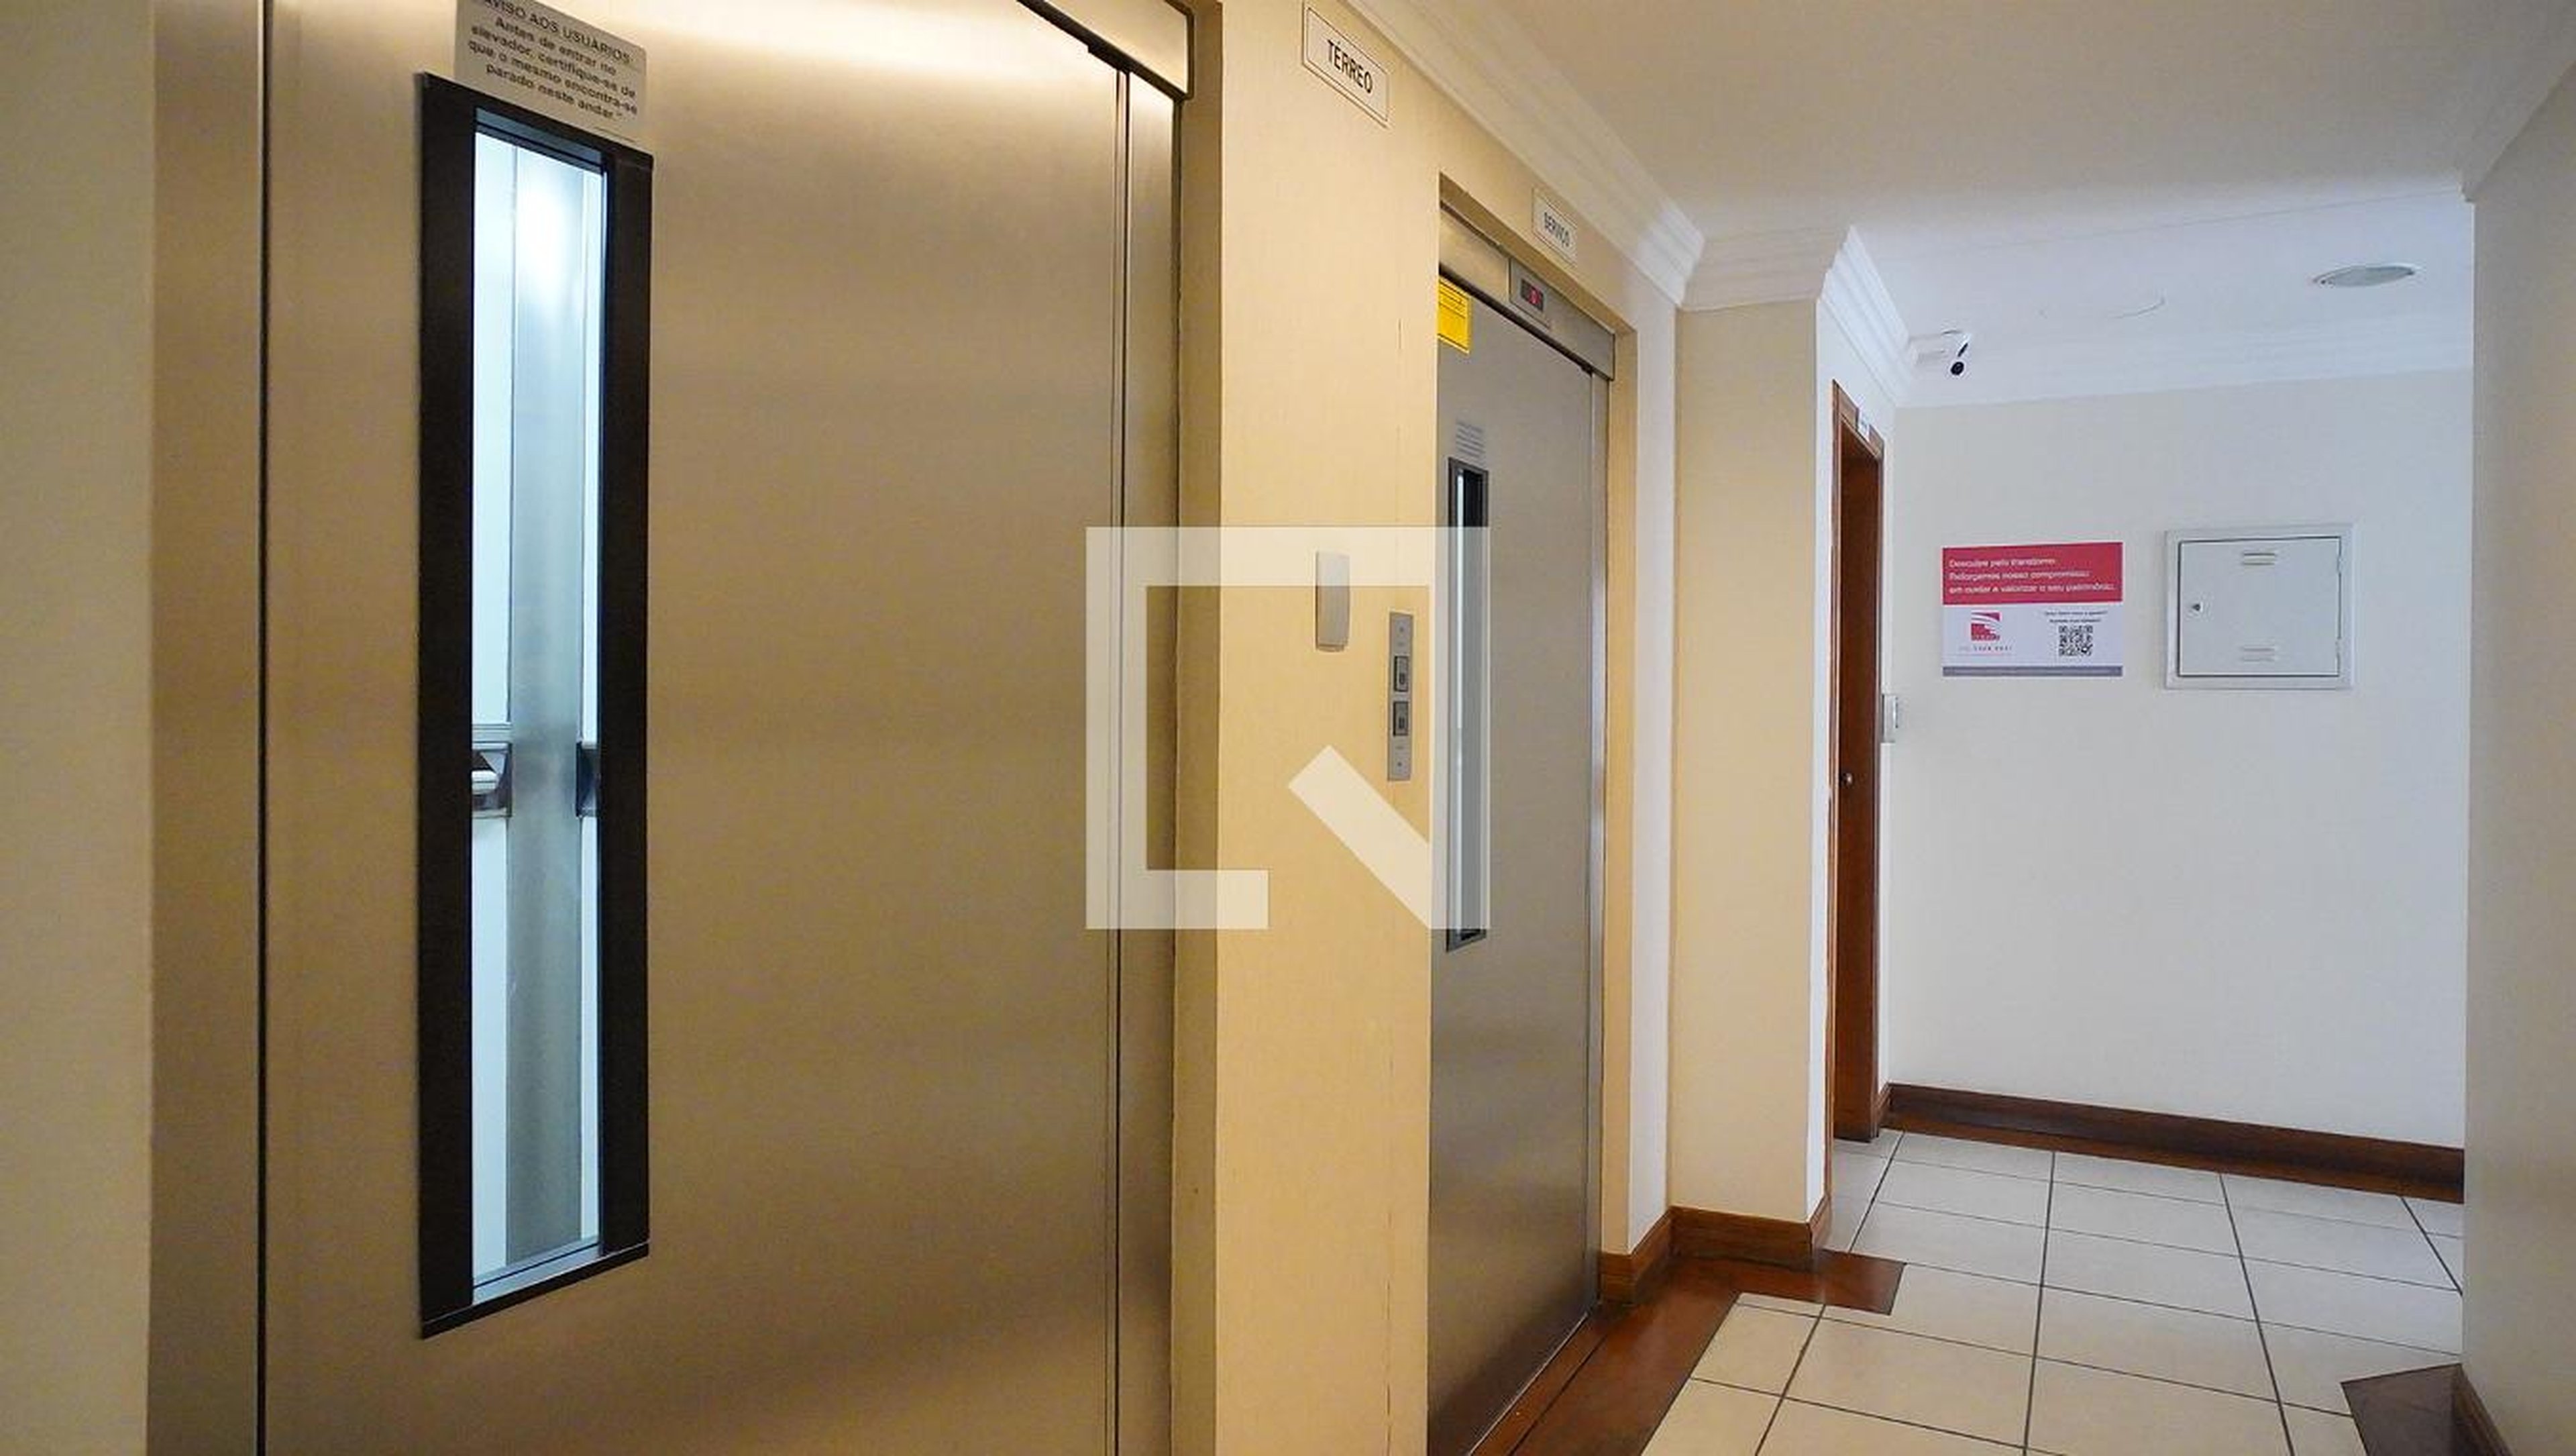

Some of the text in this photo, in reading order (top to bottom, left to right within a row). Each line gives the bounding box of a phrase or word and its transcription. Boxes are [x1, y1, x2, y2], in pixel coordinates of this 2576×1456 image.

[529, 13, 558, 33] AOS
[539, 38, 555, 50] de
[468, 40, 637, 115] que o mesmo encontra-se
[486, 64, 534, 89] parado
[538, 85, 575, 105] neste
